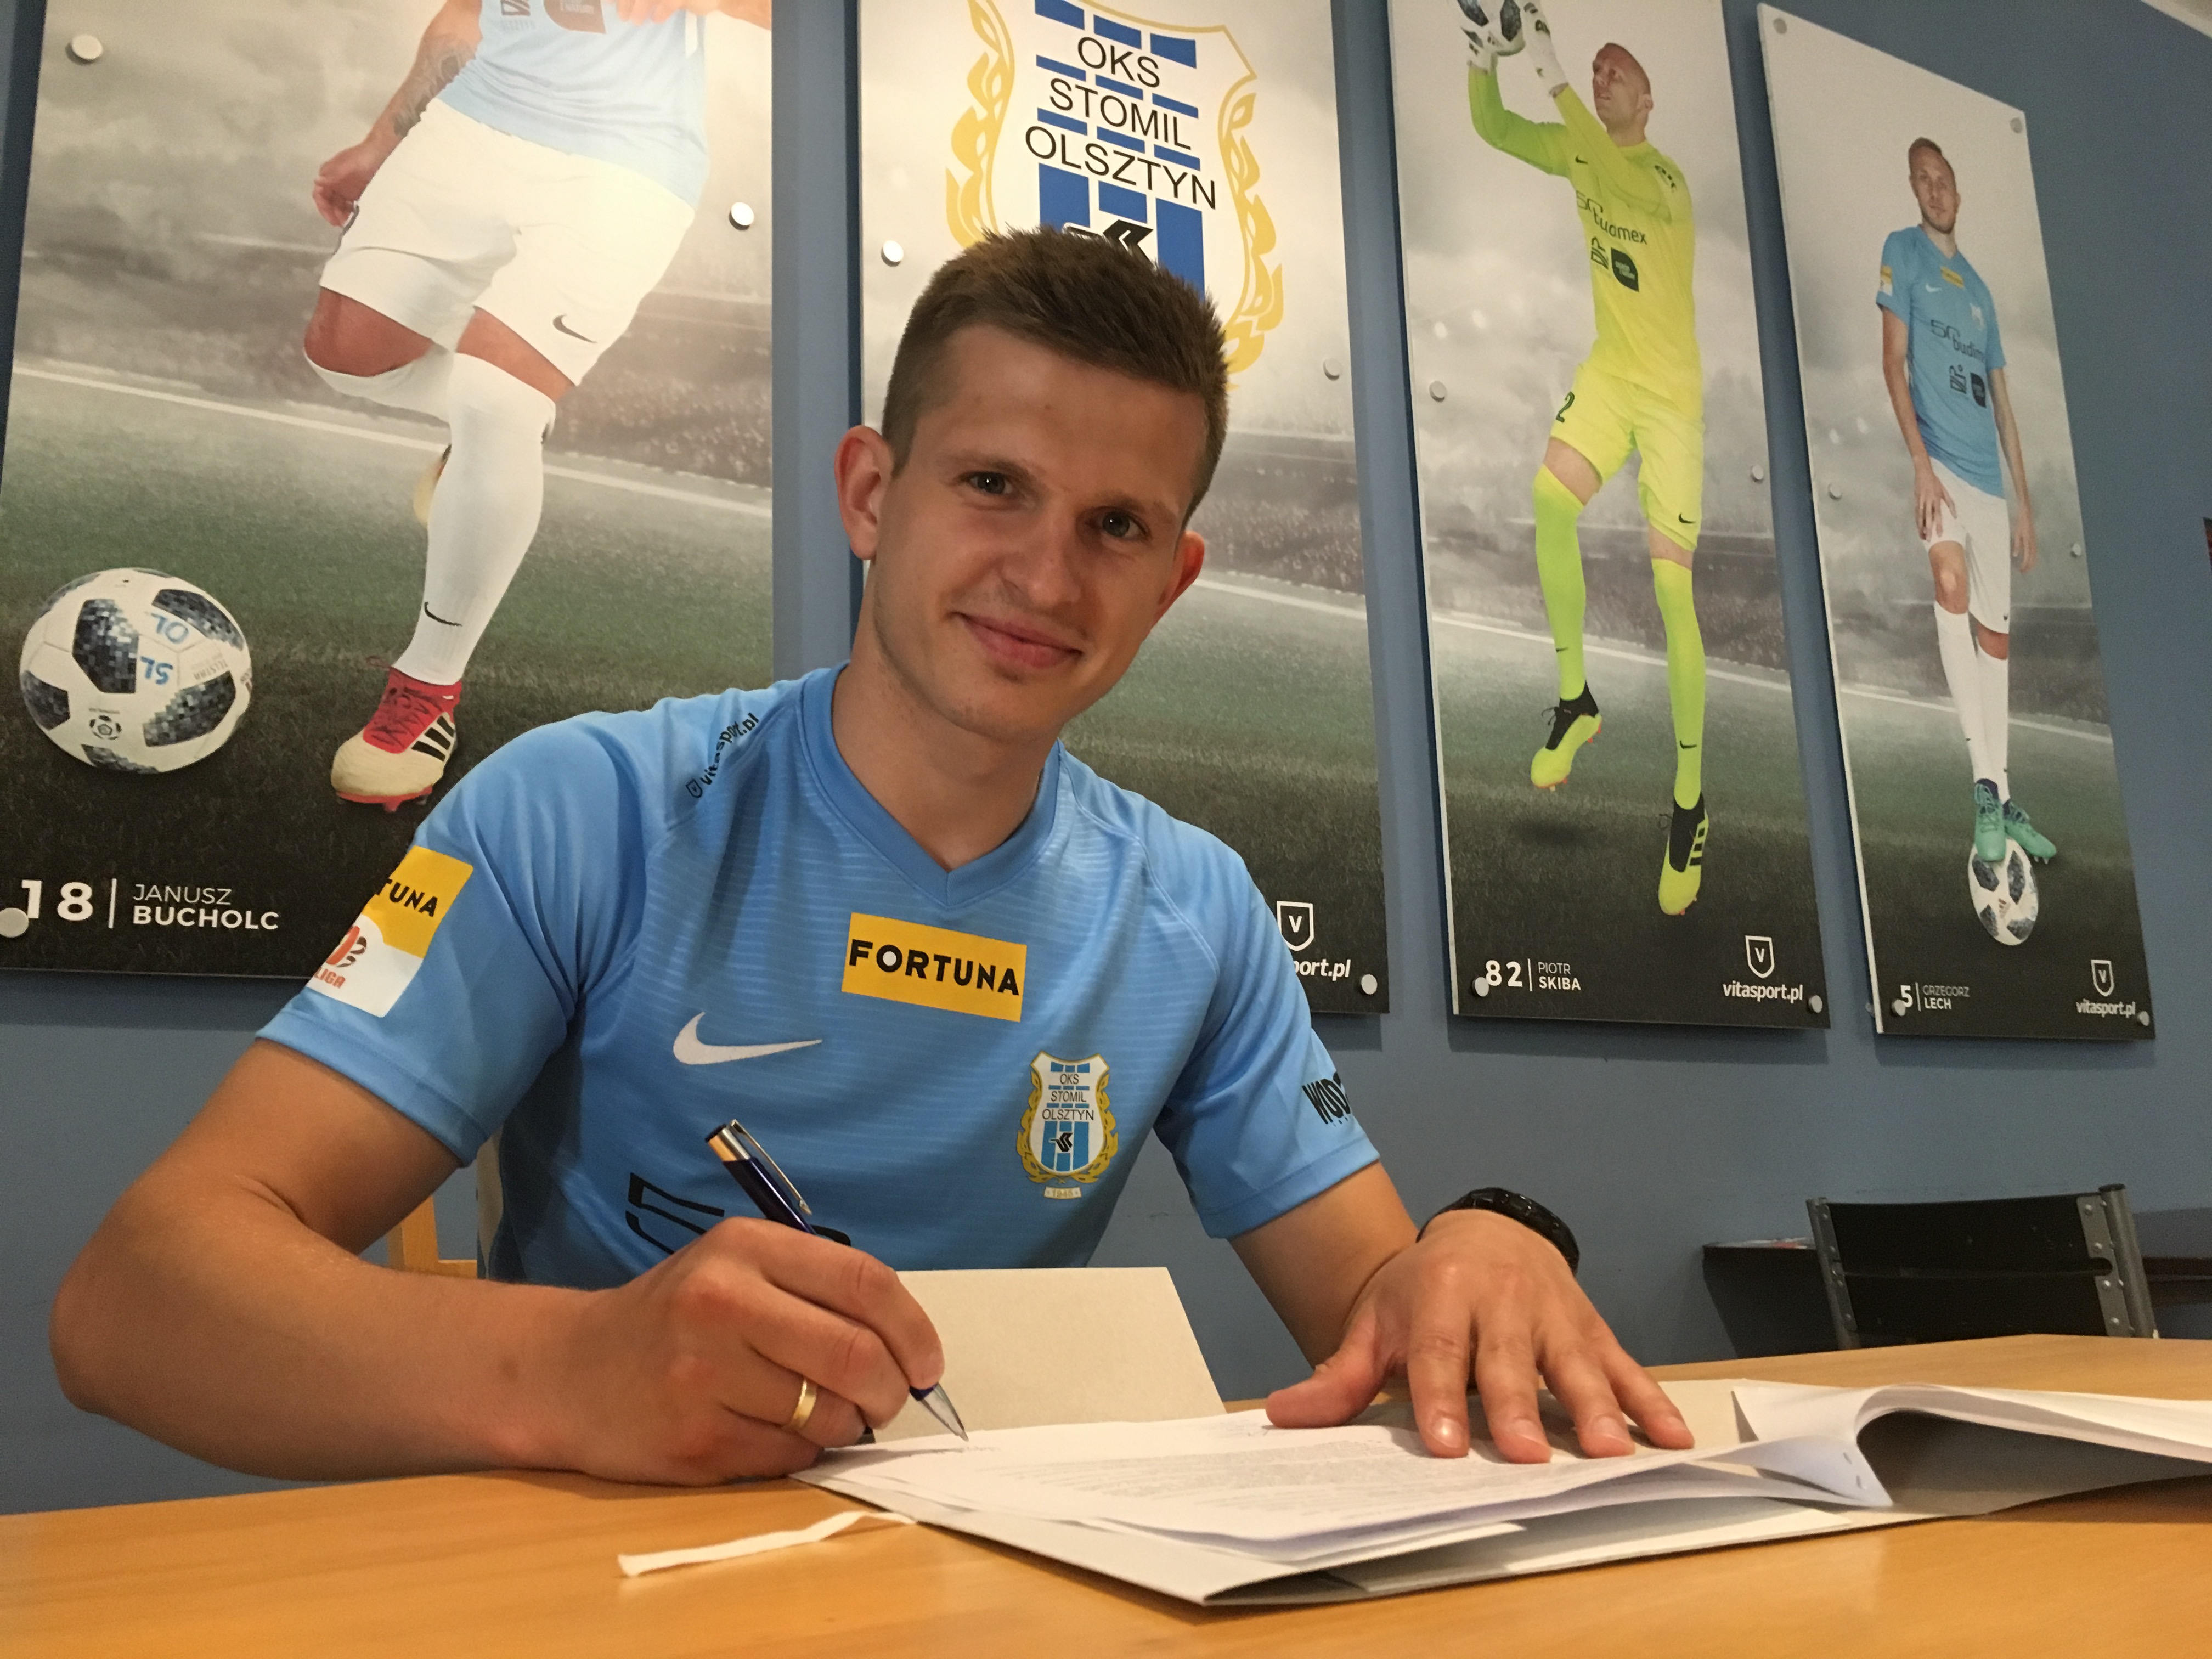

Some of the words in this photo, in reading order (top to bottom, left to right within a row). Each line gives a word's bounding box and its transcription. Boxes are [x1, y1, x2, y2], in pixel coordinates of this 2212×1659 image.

[1077, 37, 1160, 88] OKS
[1049, 78, 1192, 150] STOMIL
[1025, 126, 1216, 210] OLSZTYN
[21, 879, 93, 921] 18
[133, 884, 233, 905] JANUSZ
[133, 905, 279, 930] BUCHOLC
[849, 939, 1019, 996] FORTUNA
[1486, 960, 1523, 988] 82
[1538, 962, 1571, 975] PIOTR
[1539, 975, 1582, 991] SKIBA
[1723, 980, 1803, 1004] vitasport.pl
[1922, 985, 1970, 997] GRZEGORZ
[1900, 985, 1913, 1008] 5
[1924, 997, 1952, 1009] LECH
[2075, 998, 2136, 1018] vitasport.pl
[1059, 1073, 1079, 1085] OKS
[1050, 1091, 1087, 1102] STOMIL
[1042, 1108, 1094, 1121] OLSZTYN
